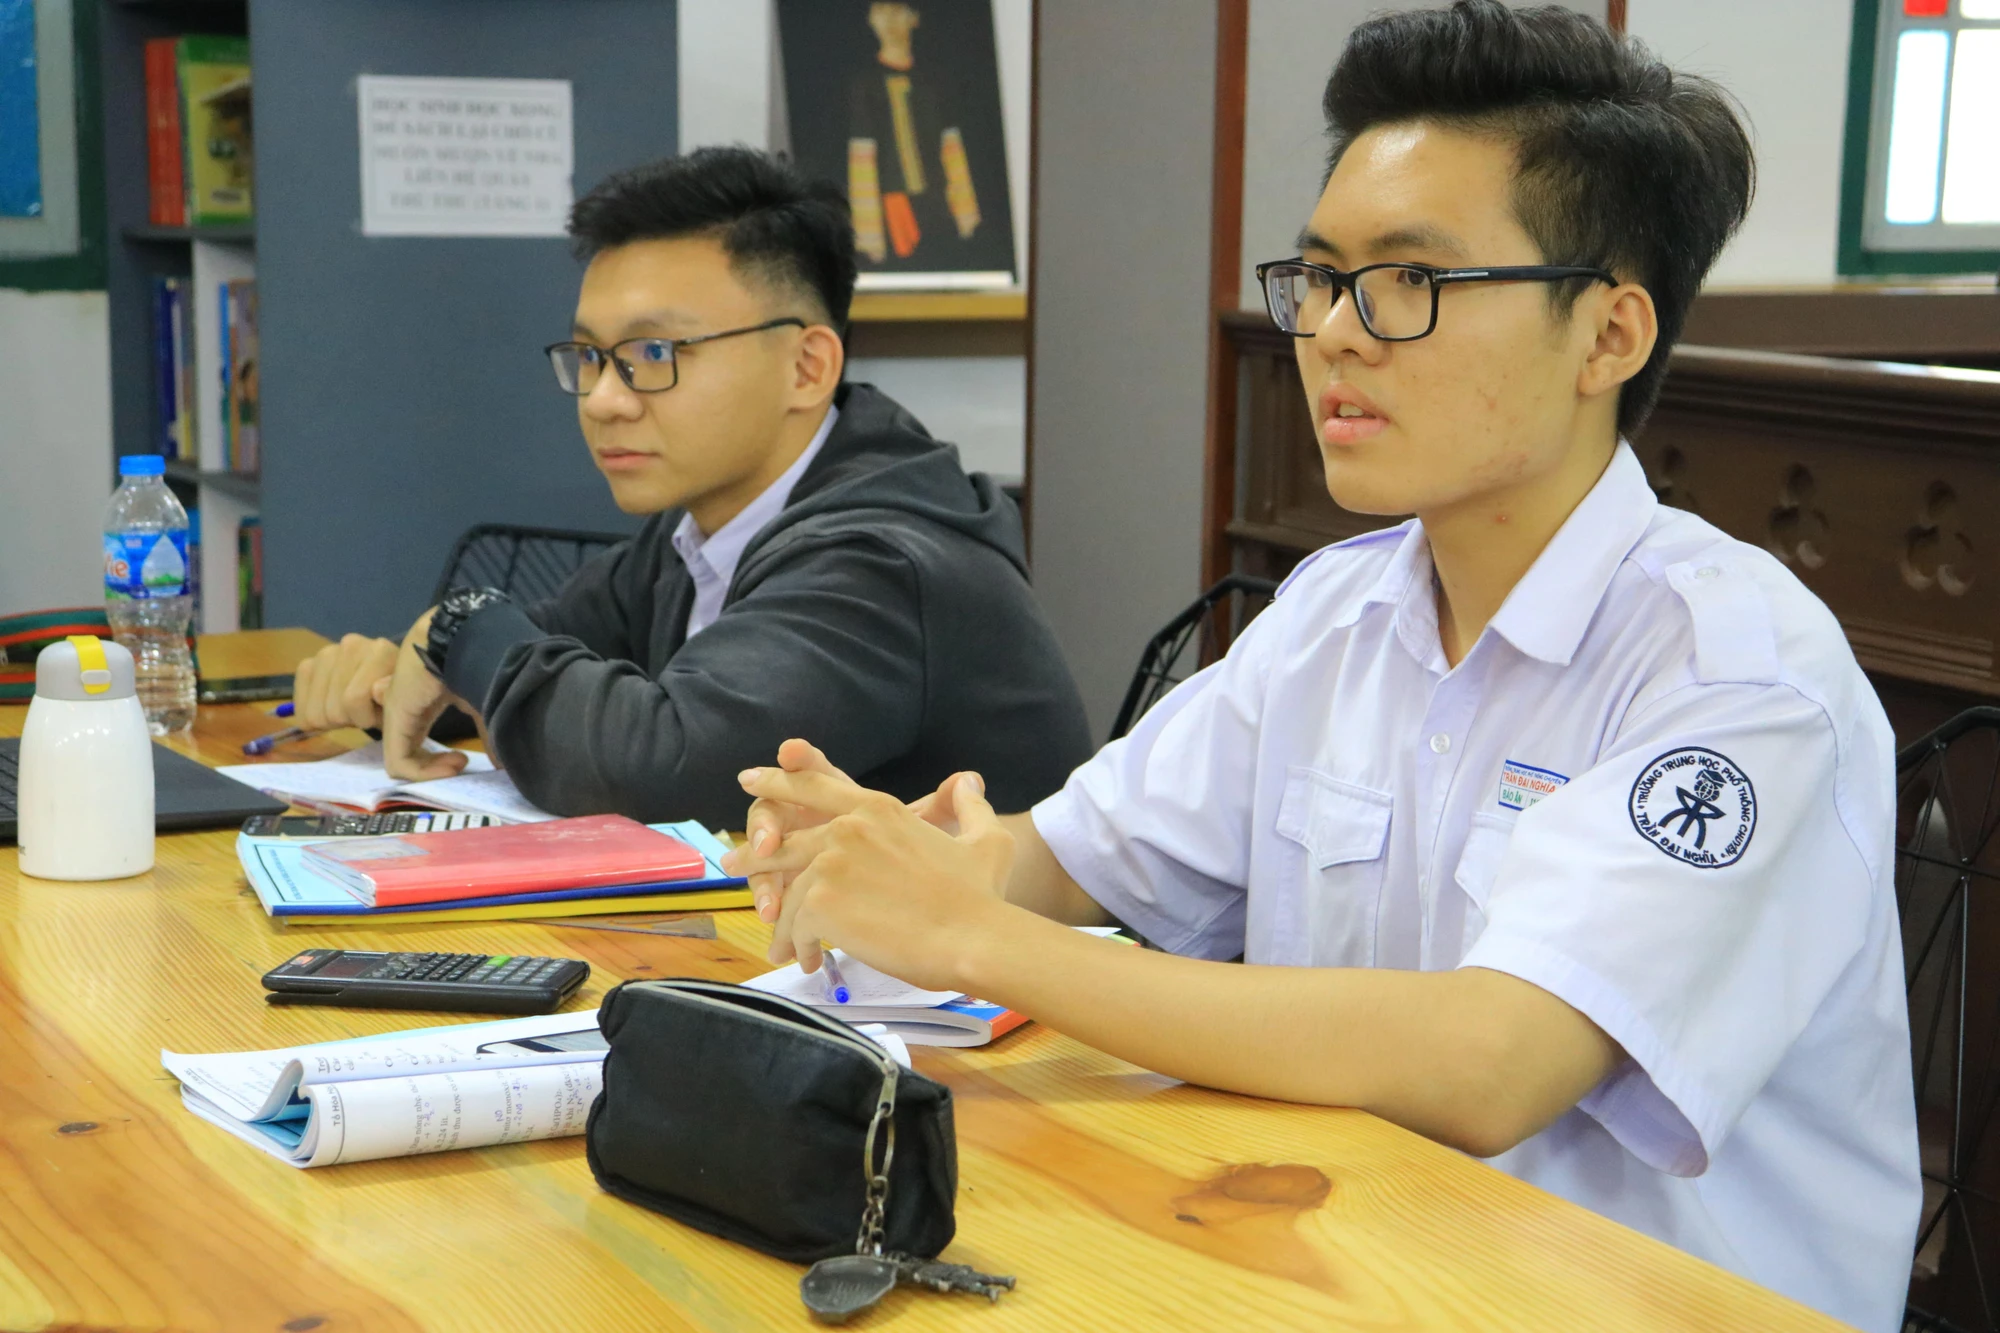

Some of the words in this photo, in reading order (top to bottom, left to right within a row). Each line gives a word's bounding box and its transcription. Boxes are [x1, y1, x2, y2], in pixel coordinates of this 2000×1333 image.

[1660, 755, 1696, 773] TRUNG
[1698, 755, 1720, 770] HỌC
[1738, 786, 1753, 822] THÔNG
[1660, 837, 1682, 854] ĐẠI
[1683, 849, 1719, 865] NGHĨA
